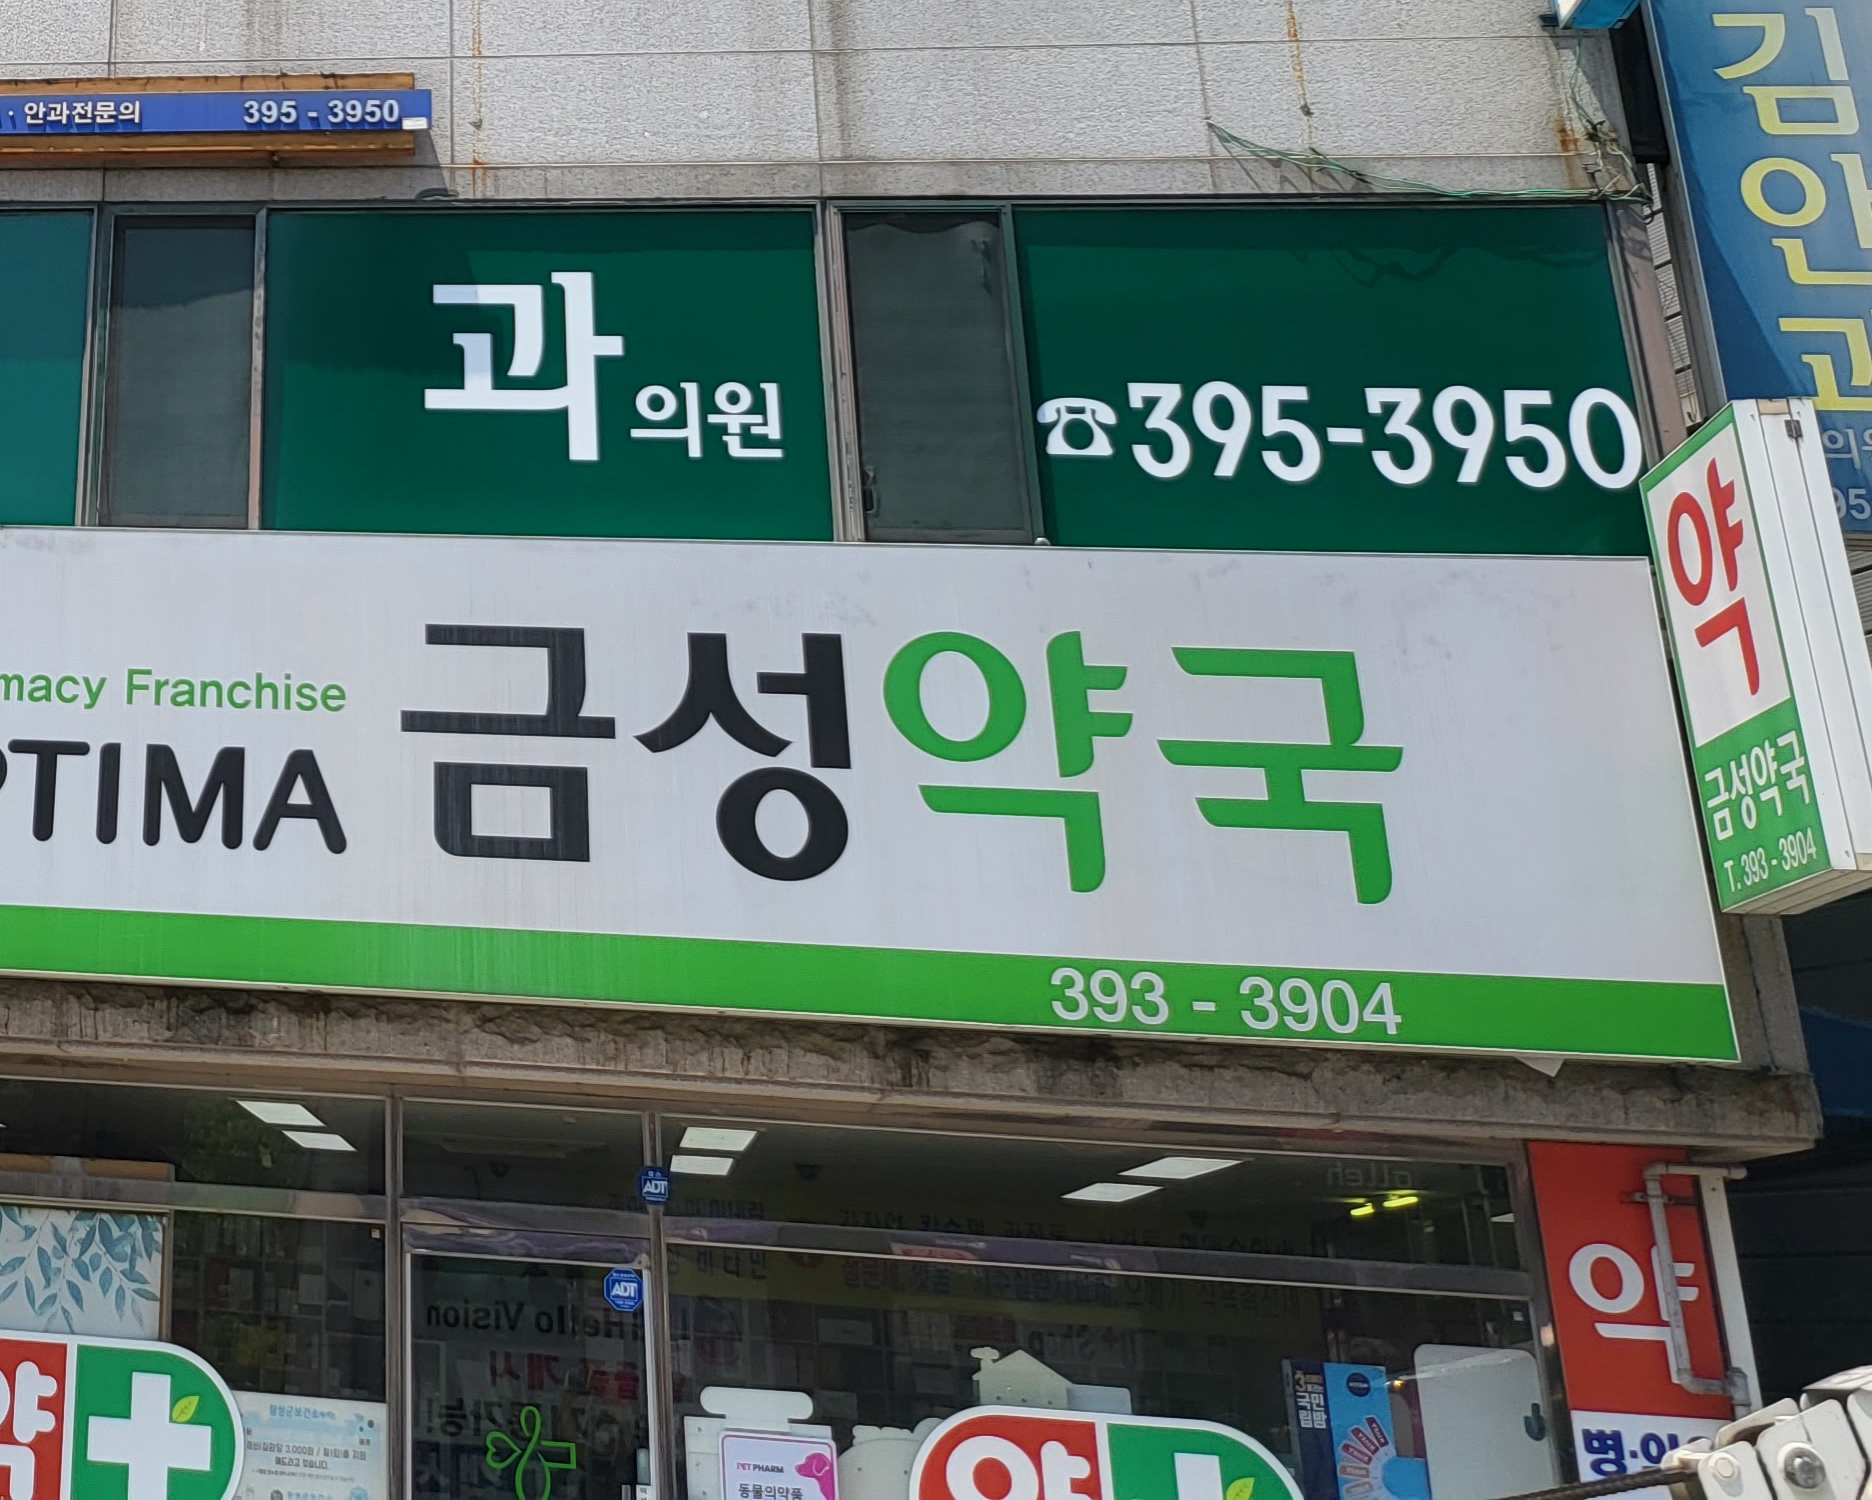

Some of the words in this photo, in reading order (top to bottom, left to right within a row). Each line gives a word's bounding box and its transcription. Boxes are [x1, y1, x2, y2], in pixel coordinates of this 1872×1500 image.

[23, 100, 141, 125] 안과전문의
[630, 380, 783, 459] 의원
[1129, 379, 1643, 490] 395-3950
[1667, 457, 1759, 696] 약
[125, 668, 346, 713] Franchise
[401, 623, 1404, 905] 금성약국
[1704, 730, 1811, 841] 금성약국
[643, 1179, 668, 1195] ADT
[611, 1281, 639, 1298] ADT
[1568, 1243, 1699, 1384] 약
